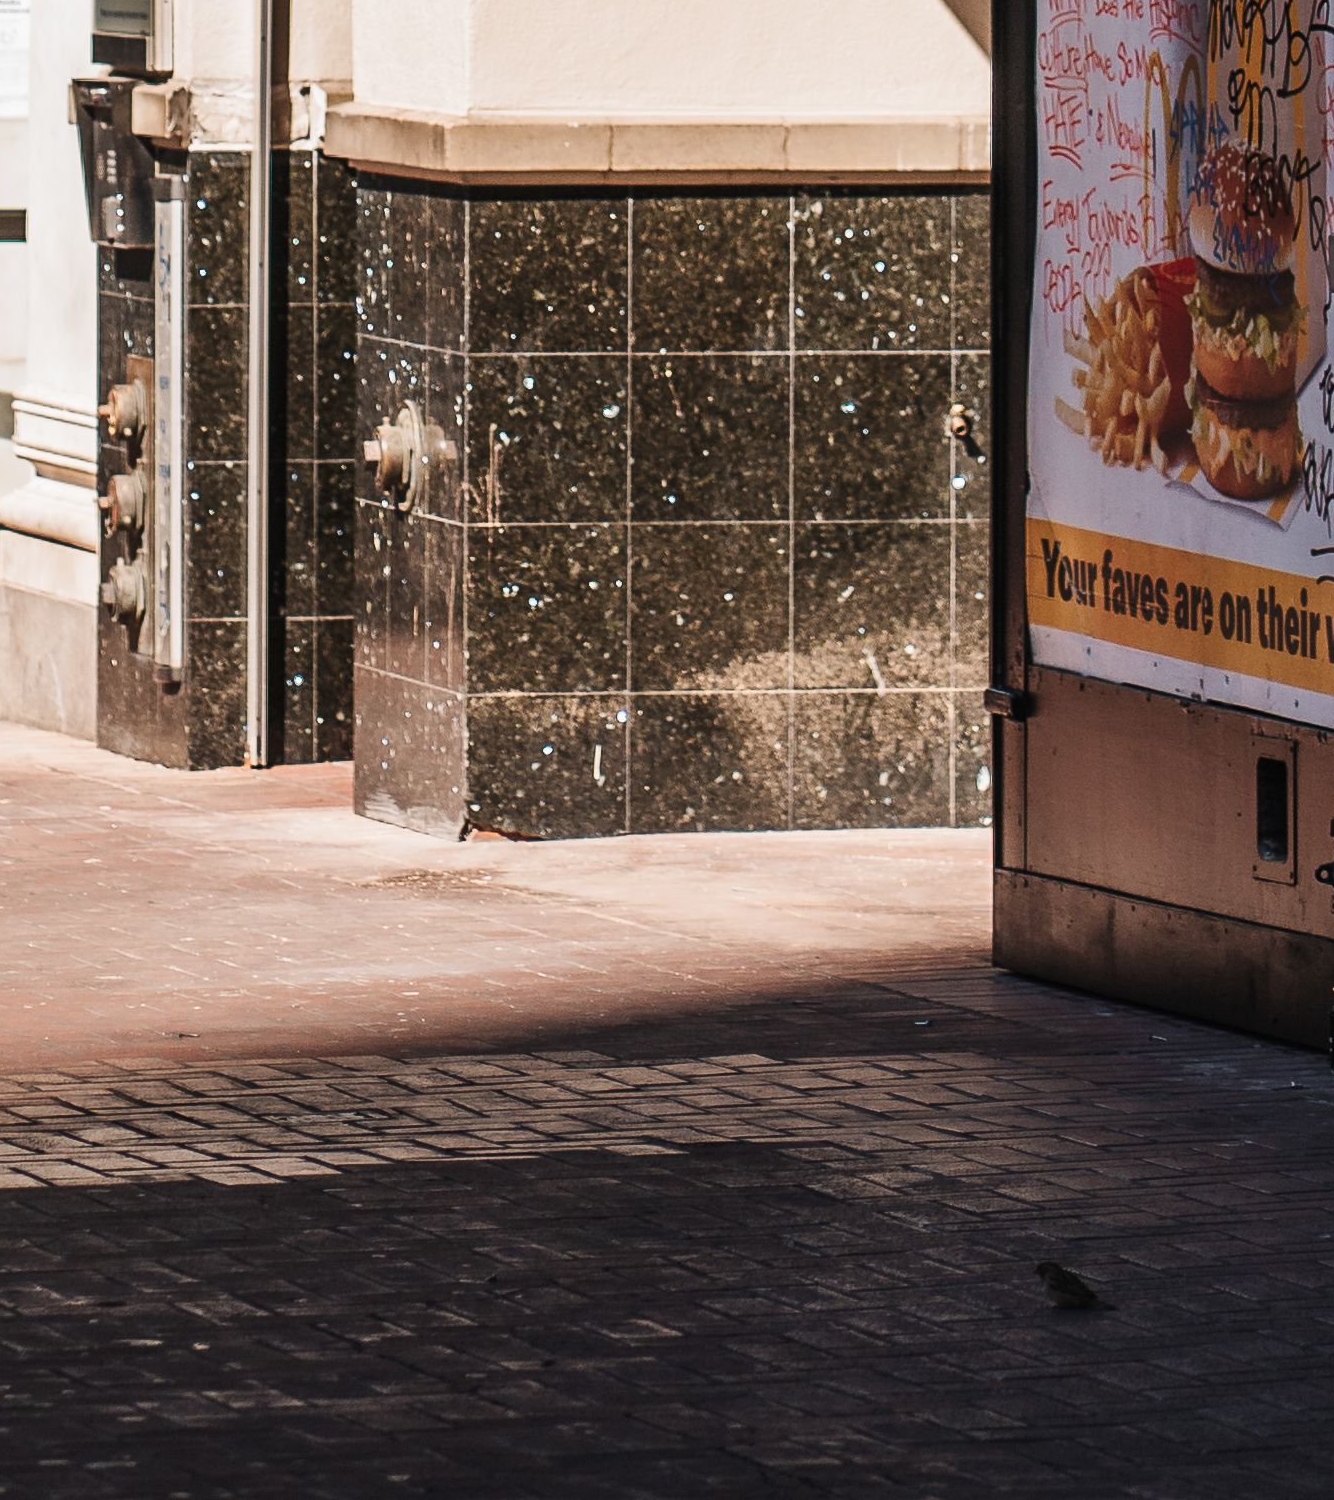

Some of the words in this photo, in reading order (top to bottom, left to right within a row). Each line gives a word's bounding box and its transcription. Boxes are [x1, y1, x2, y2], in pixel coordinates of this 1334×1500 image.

[1041, 538, 1097, 608] Your
[1101, 550, 1169, 626] faves
[1174, 582, 1213, 636] are
[1219, 591, 1251, 644] on
[1257, 586, 1320, 658] their
